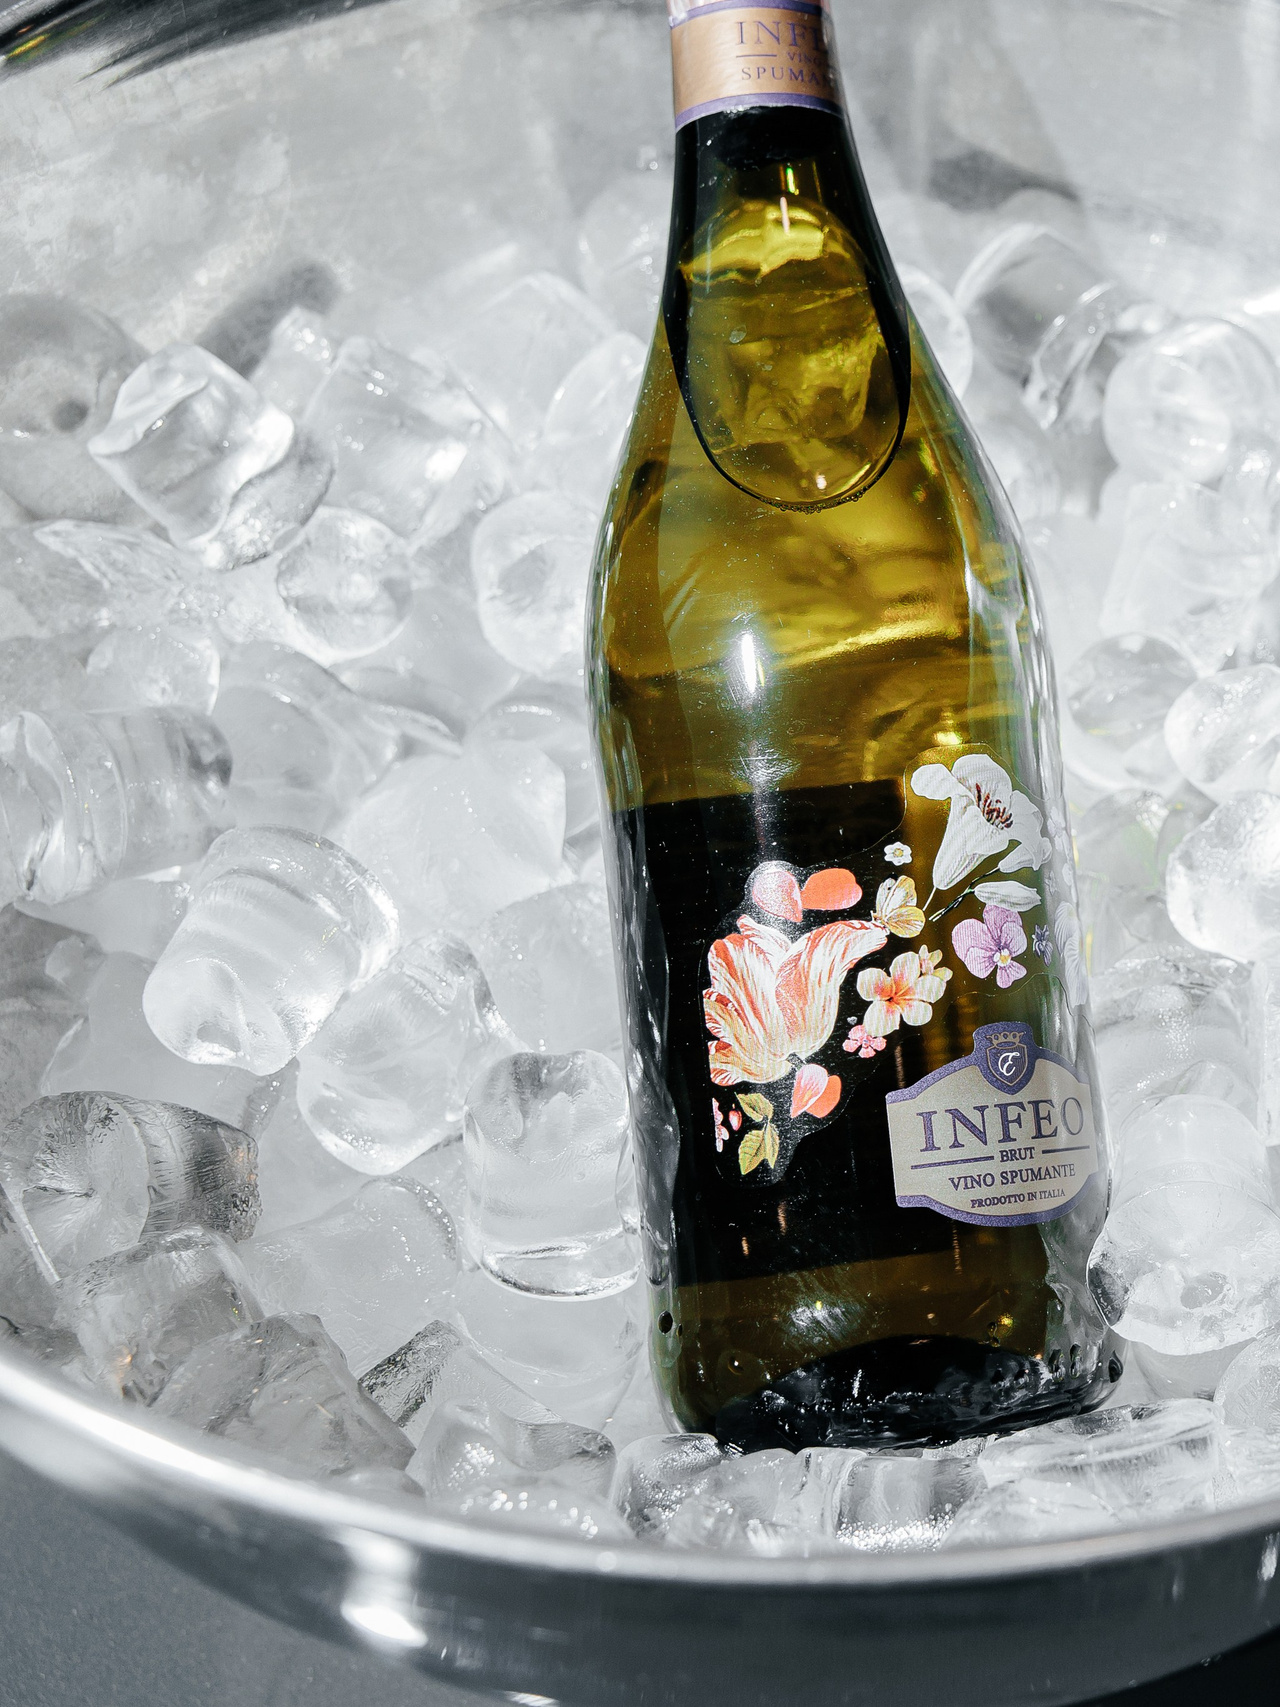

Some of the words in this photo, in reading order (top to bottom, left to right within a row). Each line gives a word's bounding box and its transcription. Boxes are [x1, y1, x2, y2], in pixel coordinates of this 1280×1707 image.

[916, 1097, 1084, 1152] INFEO
[999, 1147, 1035, 1162] BRUT
[948, 1173, 995, 1191] VINO
[1000, 1164, 1076, 1185] SPUMANTE
[970, 1193, 1025, 1208] PRODOTTO
[1027, 1192, 1037, 1202] IN
[1039, 1188, 1066, 1200] ITALIA
